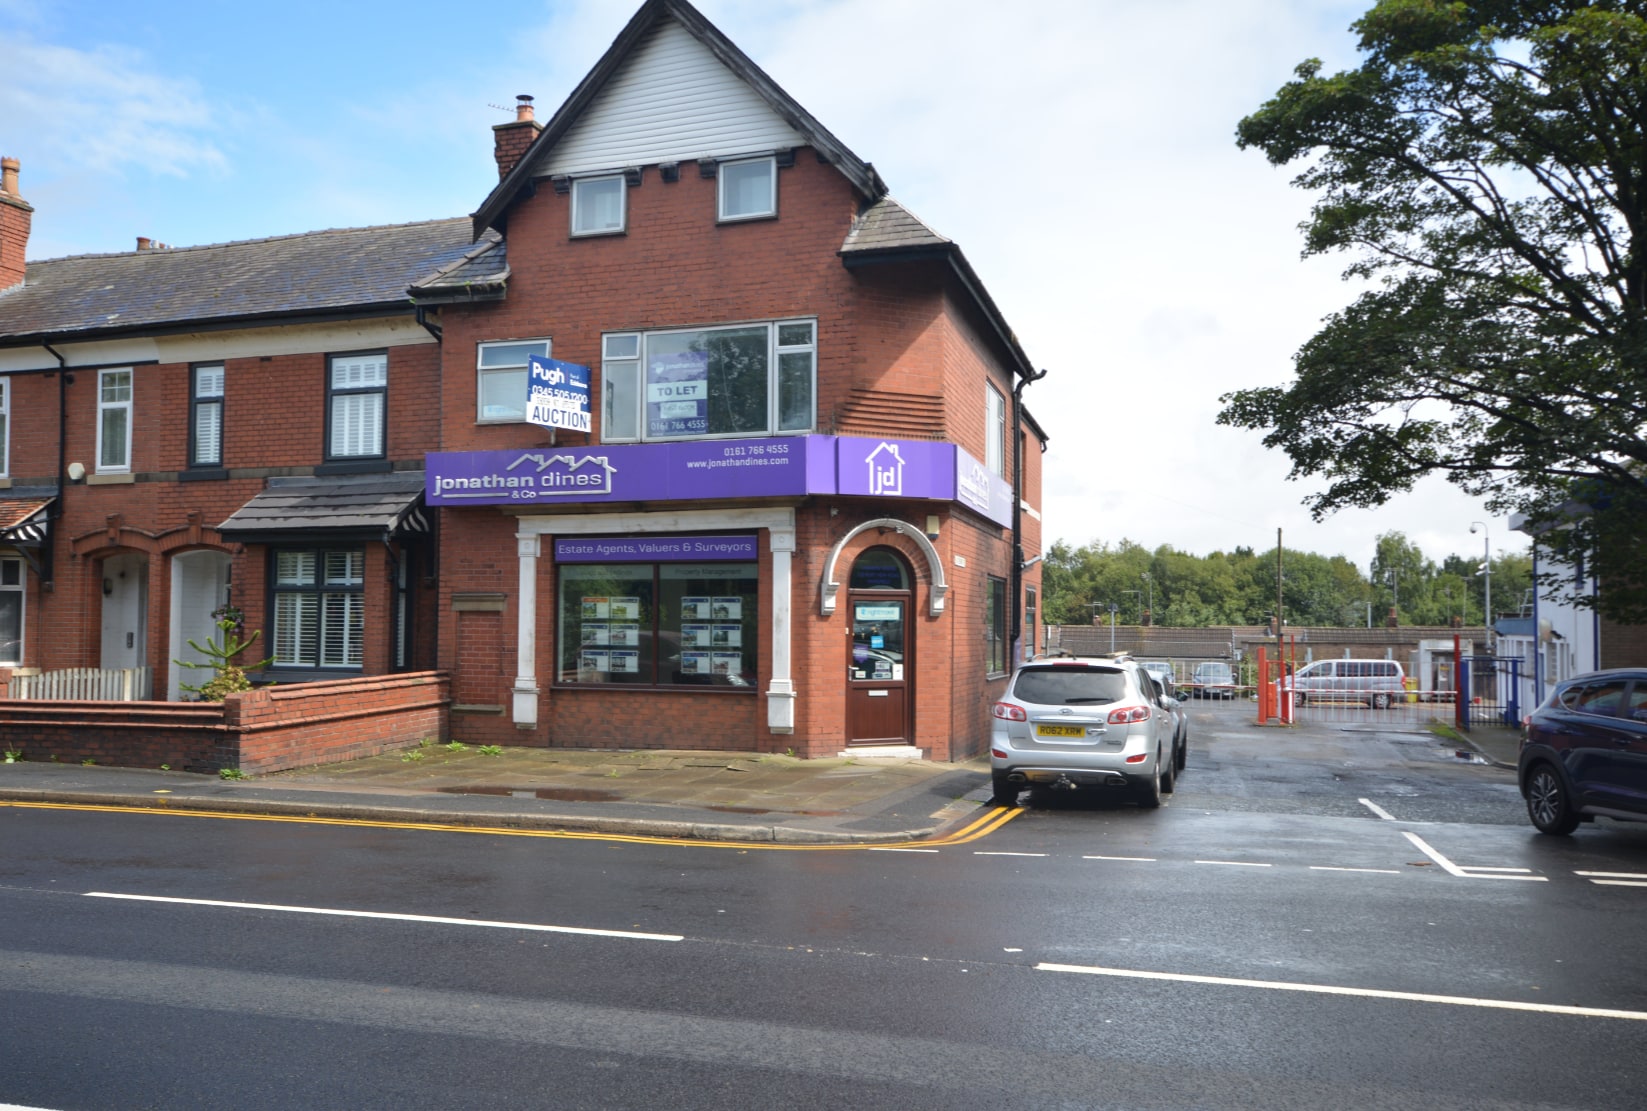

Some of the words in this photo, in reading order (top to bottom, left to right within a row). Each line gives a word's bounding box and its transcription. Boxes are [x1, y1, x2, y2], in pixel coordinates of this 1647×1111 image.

[533, 362, 565, 385] Pugh
[657, 387, 672, 396] TO
[676, 385, 698, 395] LET
[532, 406, 587, 429] AUCTION
[671, 421, 685, 430] 766
[687, 420, 705, 429] 4555
[724, 447, 746, 456] 0161
[748, 446, 764, 455] 766
[766, 445, 789, 454] 4555
[687, 457, 789, 469] www.jonathandines.com
[433, 474, 534, 496] jonathan
[541, 472, 602, 487] dines
[875, 466, 895, 494] jd
[558, 545, 593, 554] Estate
[596, 544, 637, 556] Agents,
[638, 543, 680, 553] Valuers
[682, 542, 692, 552] &
[695, 542, 752, 554] Surveyors
